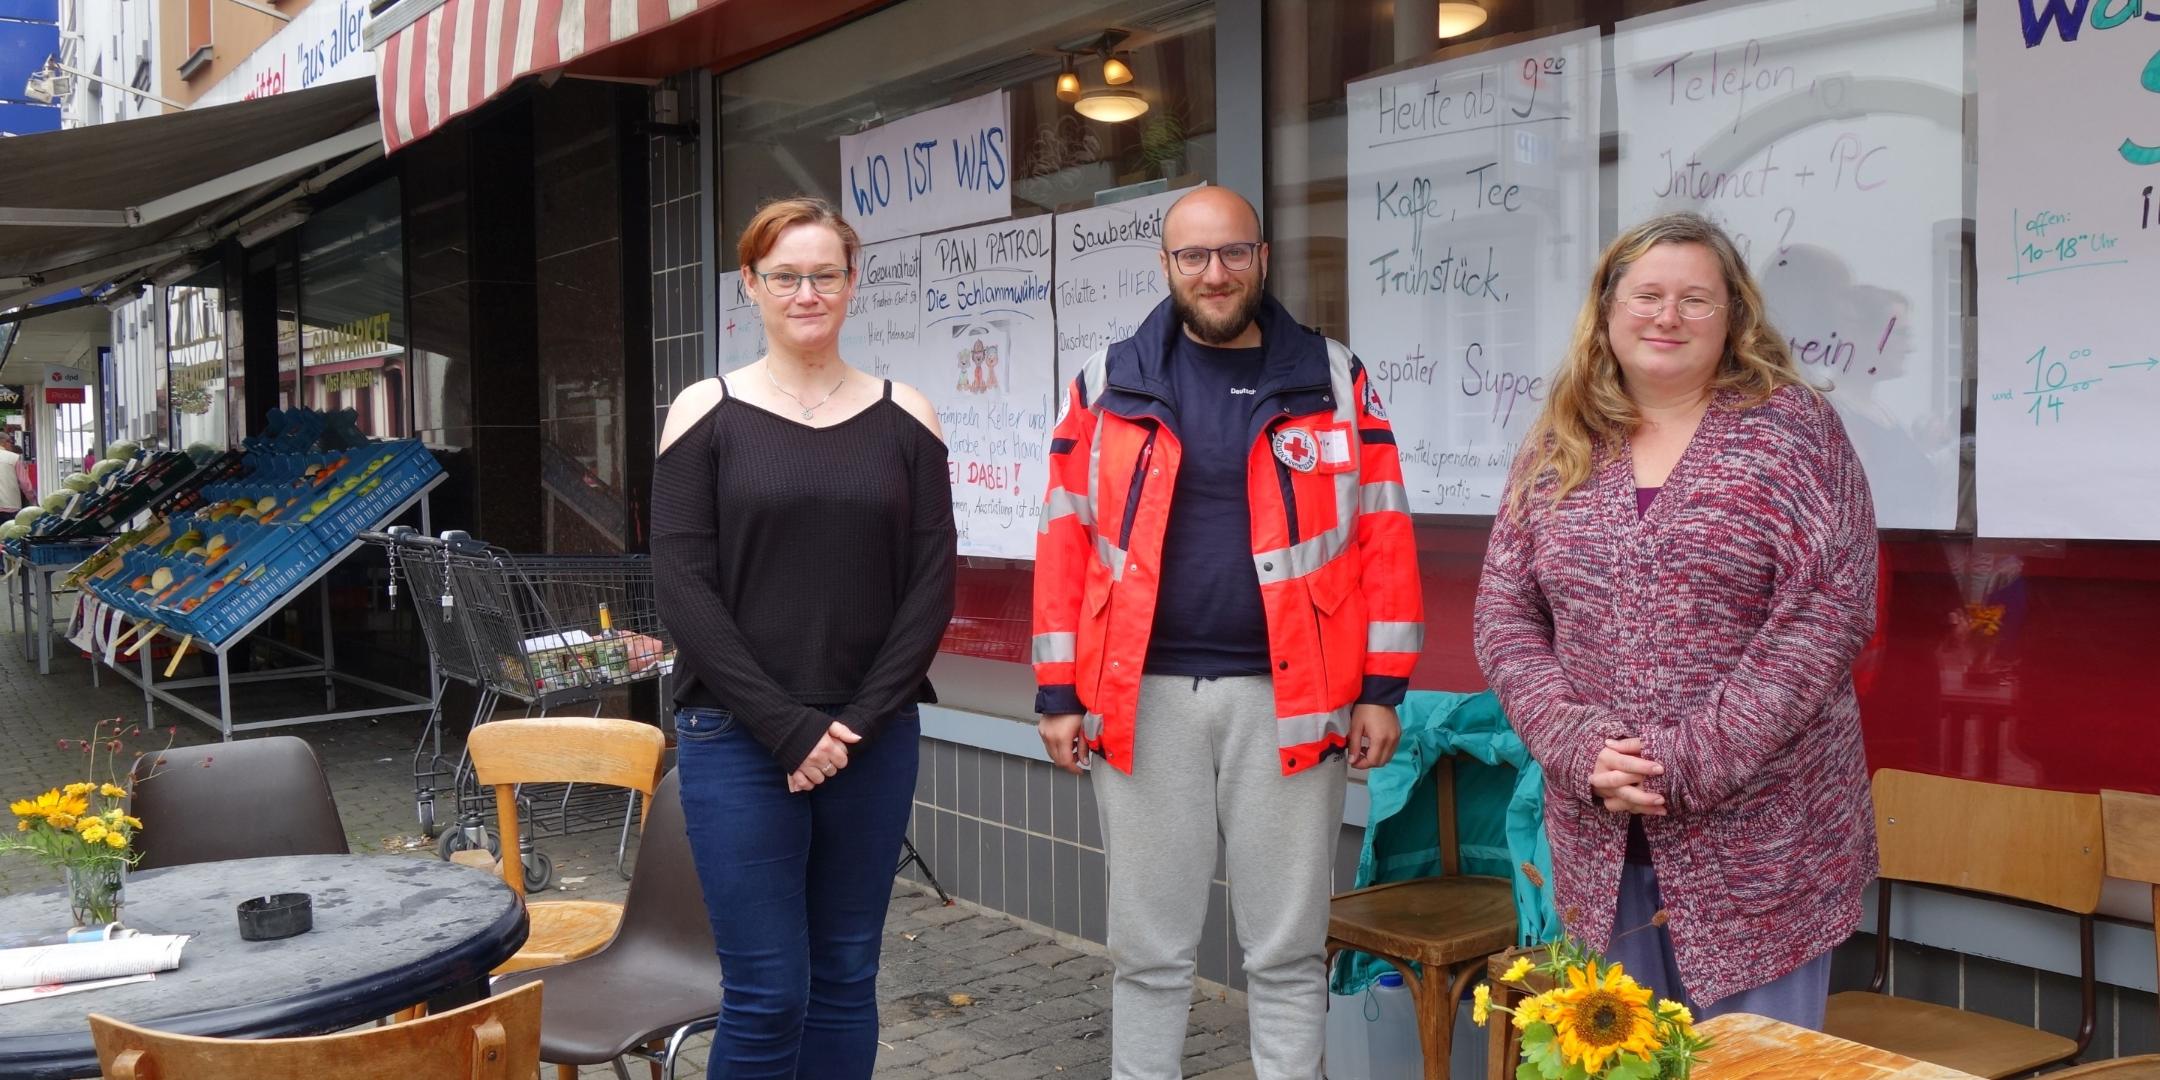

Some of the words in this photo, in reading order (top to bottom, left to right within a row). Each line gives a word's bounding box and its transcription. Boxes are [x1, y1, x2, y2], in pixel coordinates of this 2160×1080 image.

[244, 53, 286, 101] ittel
[330, 0, 364, 67] aller
[1379, 79, 1451, 134] Heute
[1463, 72, 1495, 119] ab
[850, 154, 890, 216] WO
[904, 139, 937, 202] IST
[952, 127, 1006, 194] WAS
[1830, 132, 1888, 192] PC
[1466, 162, 1522, 213] Tee
[1073, 208, 1161, 252] Sauberkeit
[2026, 211, 2071, 238] offen:
[2091, 233, 2119, 252] Uhr
[935, 238, 977, 274] PAW
[986, 227, 1049, 265] PATROL
[927, 288, 950, 312] Die
[957, 274, 1050, 310] Schlammwühler
[1118, 269, 1158, 298] HIER
[338, 312, 391, 360] MARKET
[1230, 387, 1257, 395] Deutsch
[1377, 344, 1438, 404] später
[1462, 343, 1545, 429] Suppe
[1992, 389, 2013, 400] und
[988, 399, 1026, 430] Keller
[1029, 394, 1048, 434] und
[989, 437, 1008, 465] per
[1012, 431, 1045, 464] Hand
[1400, 440, 1481, 477] smittelspenden
[948, 461, 960, 485] EI
[967, 461, 1008, 490] DABEI
[1435, 480, 1471, 506] gratis
[1016, 500, 1028, 518] ist
